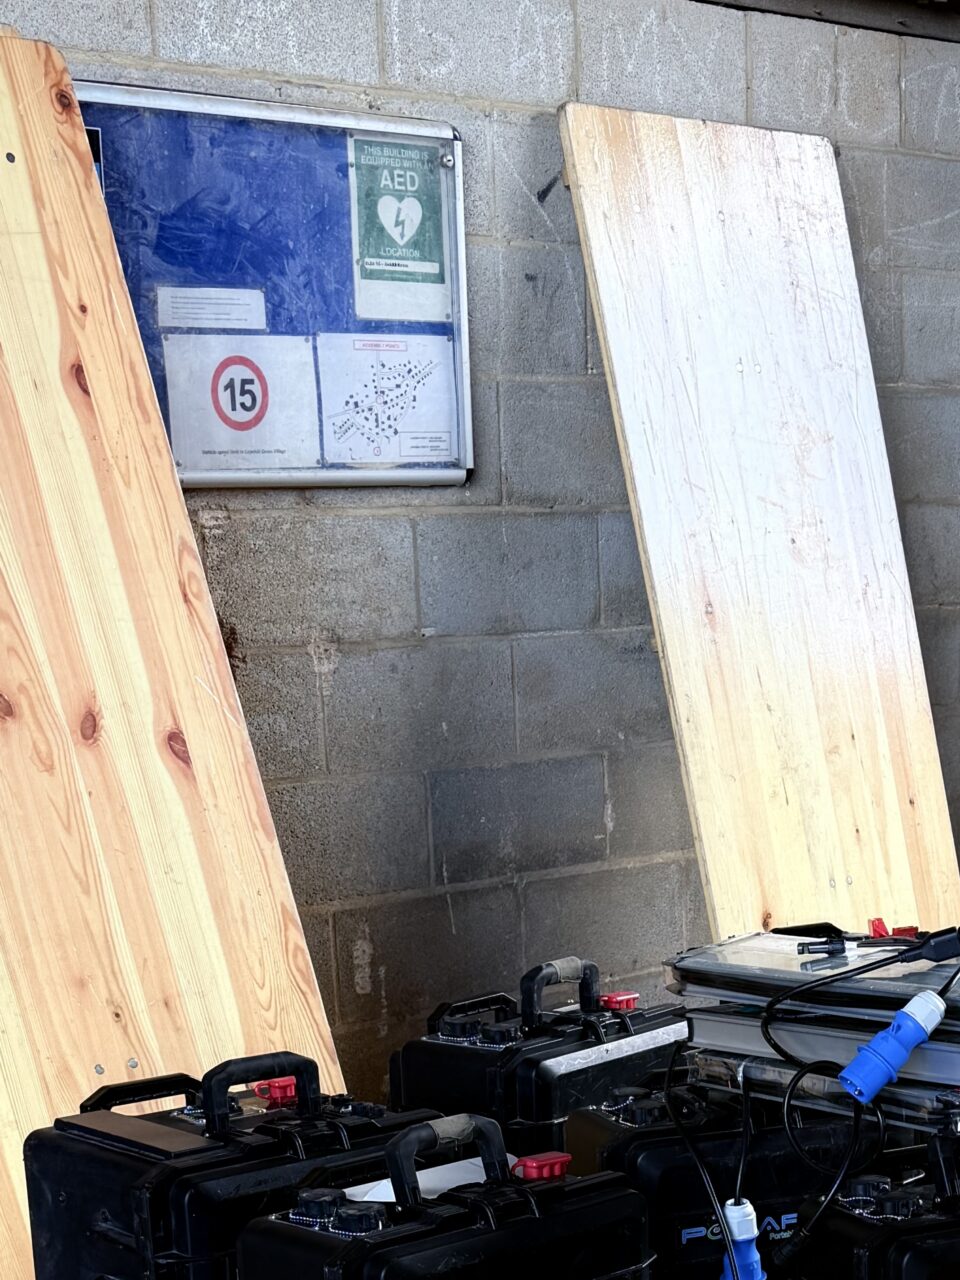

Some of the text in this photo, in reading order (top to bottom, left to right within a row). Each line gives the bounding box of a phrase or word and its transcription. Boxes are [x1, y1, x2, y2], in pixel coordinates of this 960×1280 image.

[364, 146, 429, 160] THIS BUILDING IS
[361, 156, 401, 167] EQUIPPED
[380, 169, 419, 191] AED
[381, 247, 420, 257] LOCATION
[223, 377, 257, 412] 15
